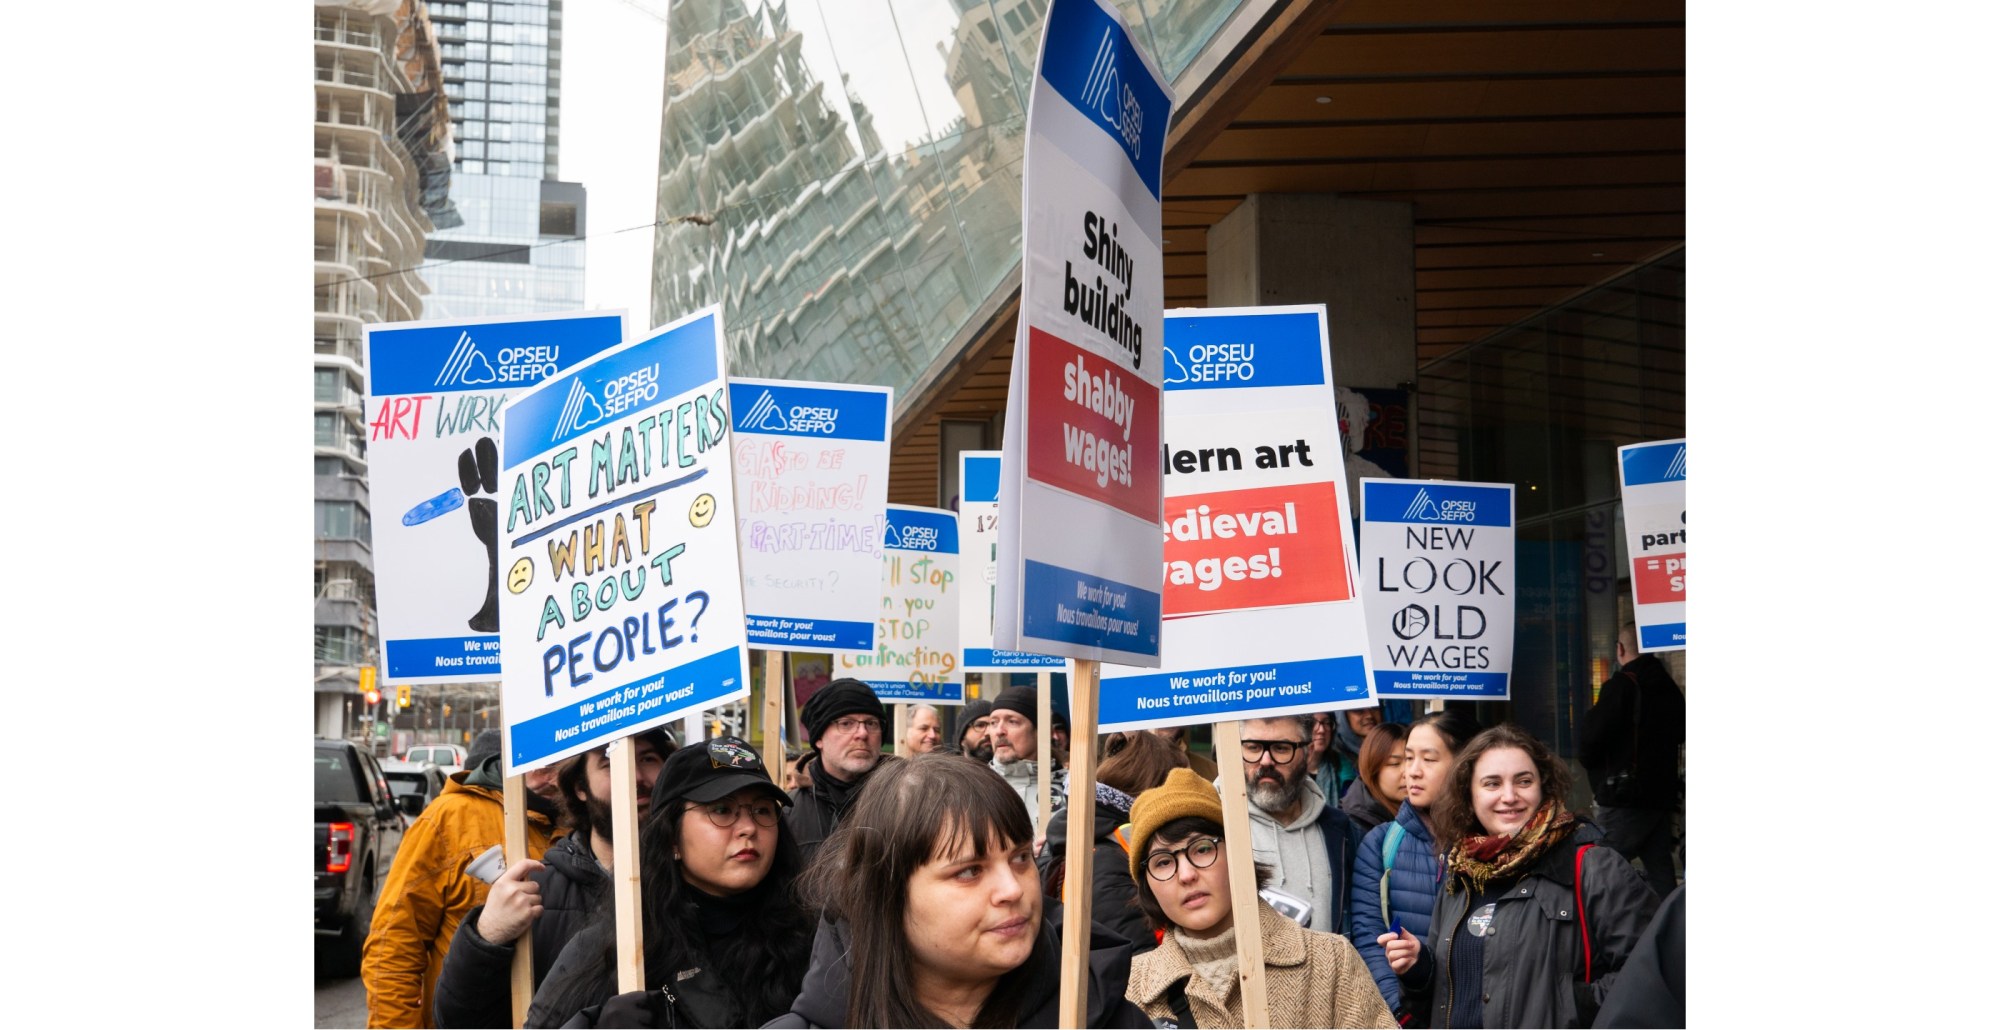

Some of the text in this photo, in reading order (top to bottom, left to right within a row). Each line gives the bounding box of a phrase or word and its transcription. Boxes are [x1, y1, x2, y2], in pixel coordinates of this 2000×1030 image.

[1122, 82, 1143, 134] OPSEU
[1121, 111, 1141, 160] SEFPO
[1083, 210, 1134, 300] Shiny
[1063, 260, 1142, 369] building
[497, 345, 559, 365] OPSEU
[1189, 343, 1254, 363] OPSEU
[497, 363, 558, 383] SEFPO
[604, 363, 660, 399] OPSEU
[1190, 362, 1254, 382] SEFPO
[604, 383, 659, 418] SEFPO
[1063, 354, 1134, 442] shabby
[370, 395, 433, 441] ART
[790, 406, 838, 421] OPSEU
[788, 419, 836, 434] SEFPO
[507, 387, 728, 533] ART MATTERS
[817, 448, 845, 469] BE
[1063, 422, 1132, 488] wages!
[1254, 439, 1314, 469] art
[1441, 500, 1476, 511] OPSEU
[1441, 510, 1475, 522] SEFPO
[547, 499, 657, 582] WHAT
[902, 525, 938, 540] OPSEU
[902, 537, 937, 551] SEFPO
[1406, 526, 1474, 550] NEW
[1379, 556, 1504, 596] LOOK
[537, 542, 686, 642] ABOUT
[1077, 579, 1127, 611] We work for you!
[904, 598, 934, 618] you
[1057, 603, 1139, 636] Nous travaillons pour vous!
[756, 619, 778, 627] work
[779, 620, 792, 630] for
[794, 622, 813, 631] you!
[1392, 603, 1487, 640] OLD
[464, 640, 480, 651] We
[543, 590, 710, 697] PEOPLE?
[789, 632, 810, 641] pour
[812, 633, 836, 641] vous!
[435, 652, 501, 667] Nous travai
[1001, 658, 1030, 666] syndicat
[1387, 644, 1489, 669] WAGES
[909, 670, 949, 695] OUT
[1170, 668, 1277, 690] We work for you!
[1412, 673, 1422, 681] We
[1441, 674, 1452, 682] for
[579, 676, 665, 717] We work for you!
[1137, 681, 1312, 710] Nous travaillons pour vous!
[555, 683, 694, 742] Nous travaillons pour vous!
